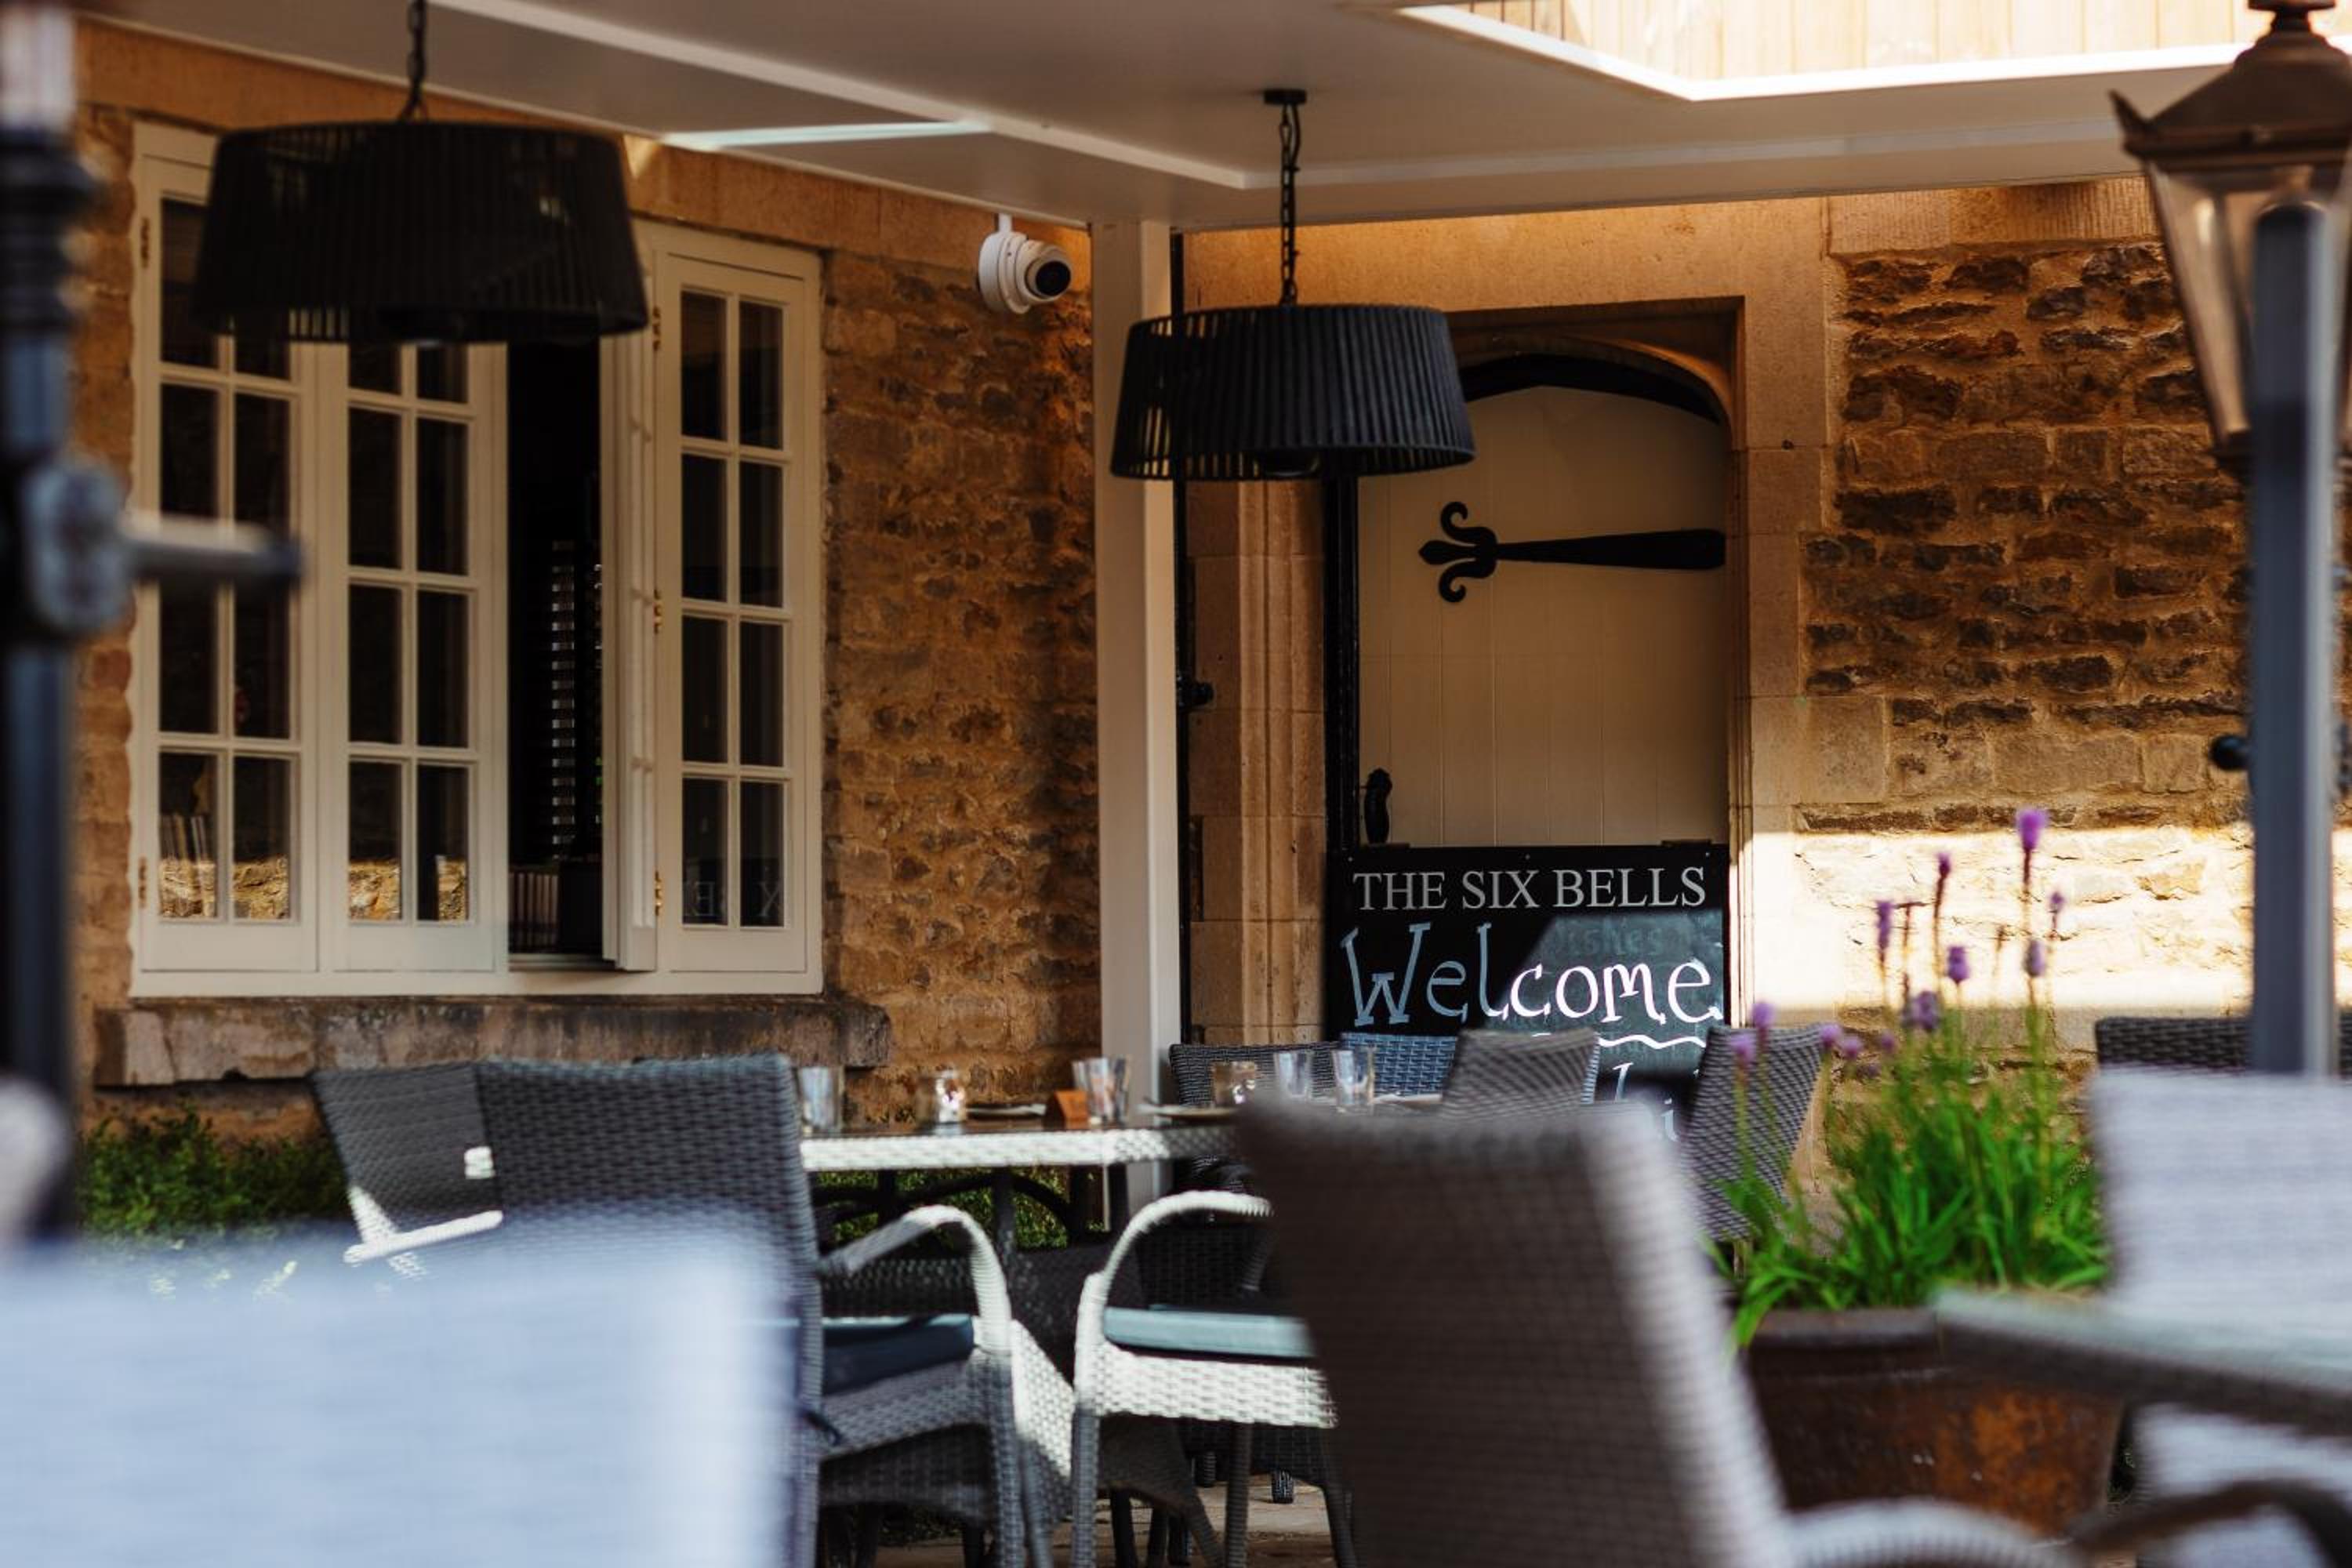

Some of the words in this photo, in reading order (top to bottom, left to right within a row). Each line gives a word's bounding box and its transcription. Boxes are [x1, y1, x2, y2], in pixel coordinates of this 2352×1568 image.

[1353, 872, 1446, 909] THE
[1462, 869, 1541, 909] SIX
[1553, 866, 1706, 908] BELLS
[1341, 922, 1723, 1026] Welcome
